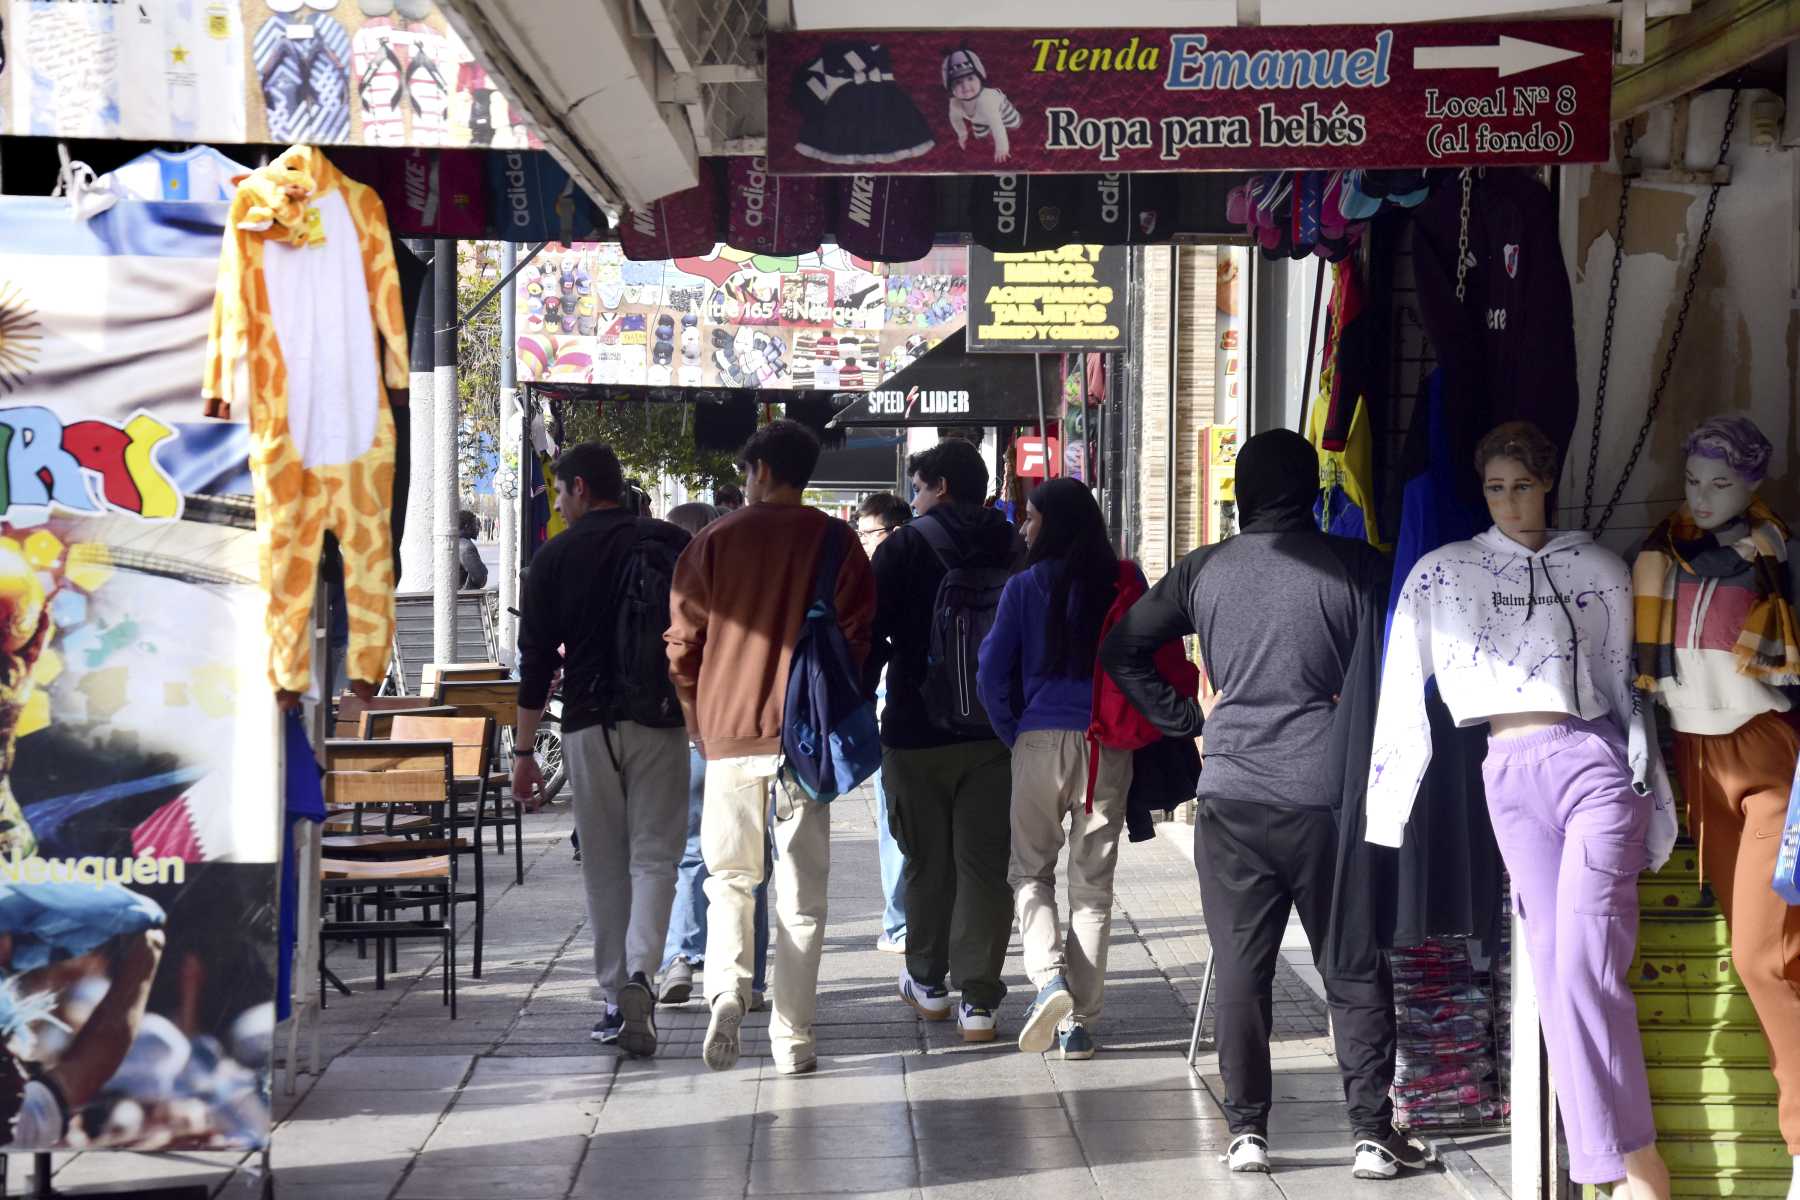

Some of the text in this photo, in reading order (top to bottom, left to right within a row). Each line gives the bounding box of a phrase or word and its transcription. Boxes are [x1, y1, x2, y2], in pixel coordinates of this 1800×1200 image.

[1031, 29, 1394, 90] Tienda Emanuel
[1425, 87, 1507, 118] Local
[1555, 85, 1577, 116] 8
[1045, 100, 1365, 161] Ropa para bebés
[1426, 120, 1575, 159] (al fondo)
[405, 159, 426, 212] NIKE
[506, 149, 530, 226] adida
[744, 302, 775, 320] 165
[868, 390, 970, 414] SPEED LIDER
[1491, 592, 1526, 608] Palm
[0, 845, 186, 890] Neuquén
